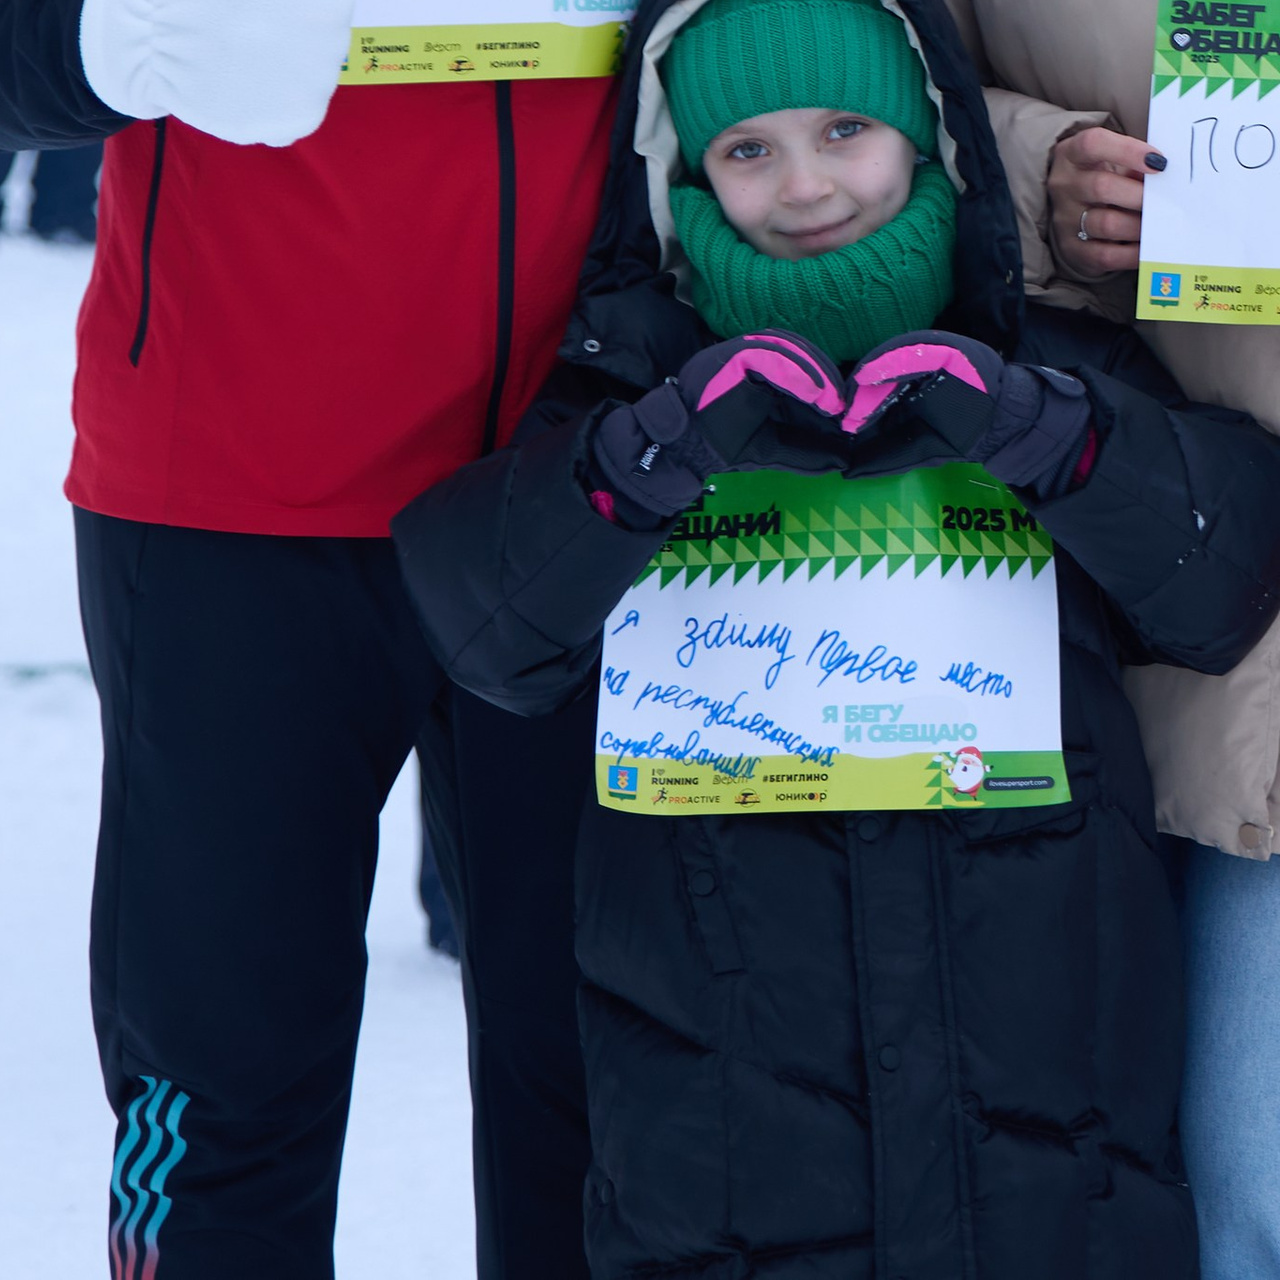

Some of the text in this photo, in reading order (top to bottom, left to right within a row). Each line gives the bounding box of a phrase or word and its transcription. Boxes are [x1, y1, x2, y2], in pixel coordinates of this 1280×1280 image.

[1171, 0, 1266, 28] ЗАБЕГ
[362, 45, 409, 54] RUNNING
[1191, 54, 1220, 64] 2025
[1194, 284, 1242, 294] RUNNING
[942, 506, 1006, 532] 2025
[666, 501, 780, 549] ЕЩАНИЙ
[822, 704, 904, 724] Я БЕГУ
[844, 723, 978, 745] И ОБЕЩАЮ
[651, 777, 699, 786] RUNNING
[762, 773, 829, 783] #БЕГИГЛИНО
[668, 795, 720, 804] PROACTIVE
